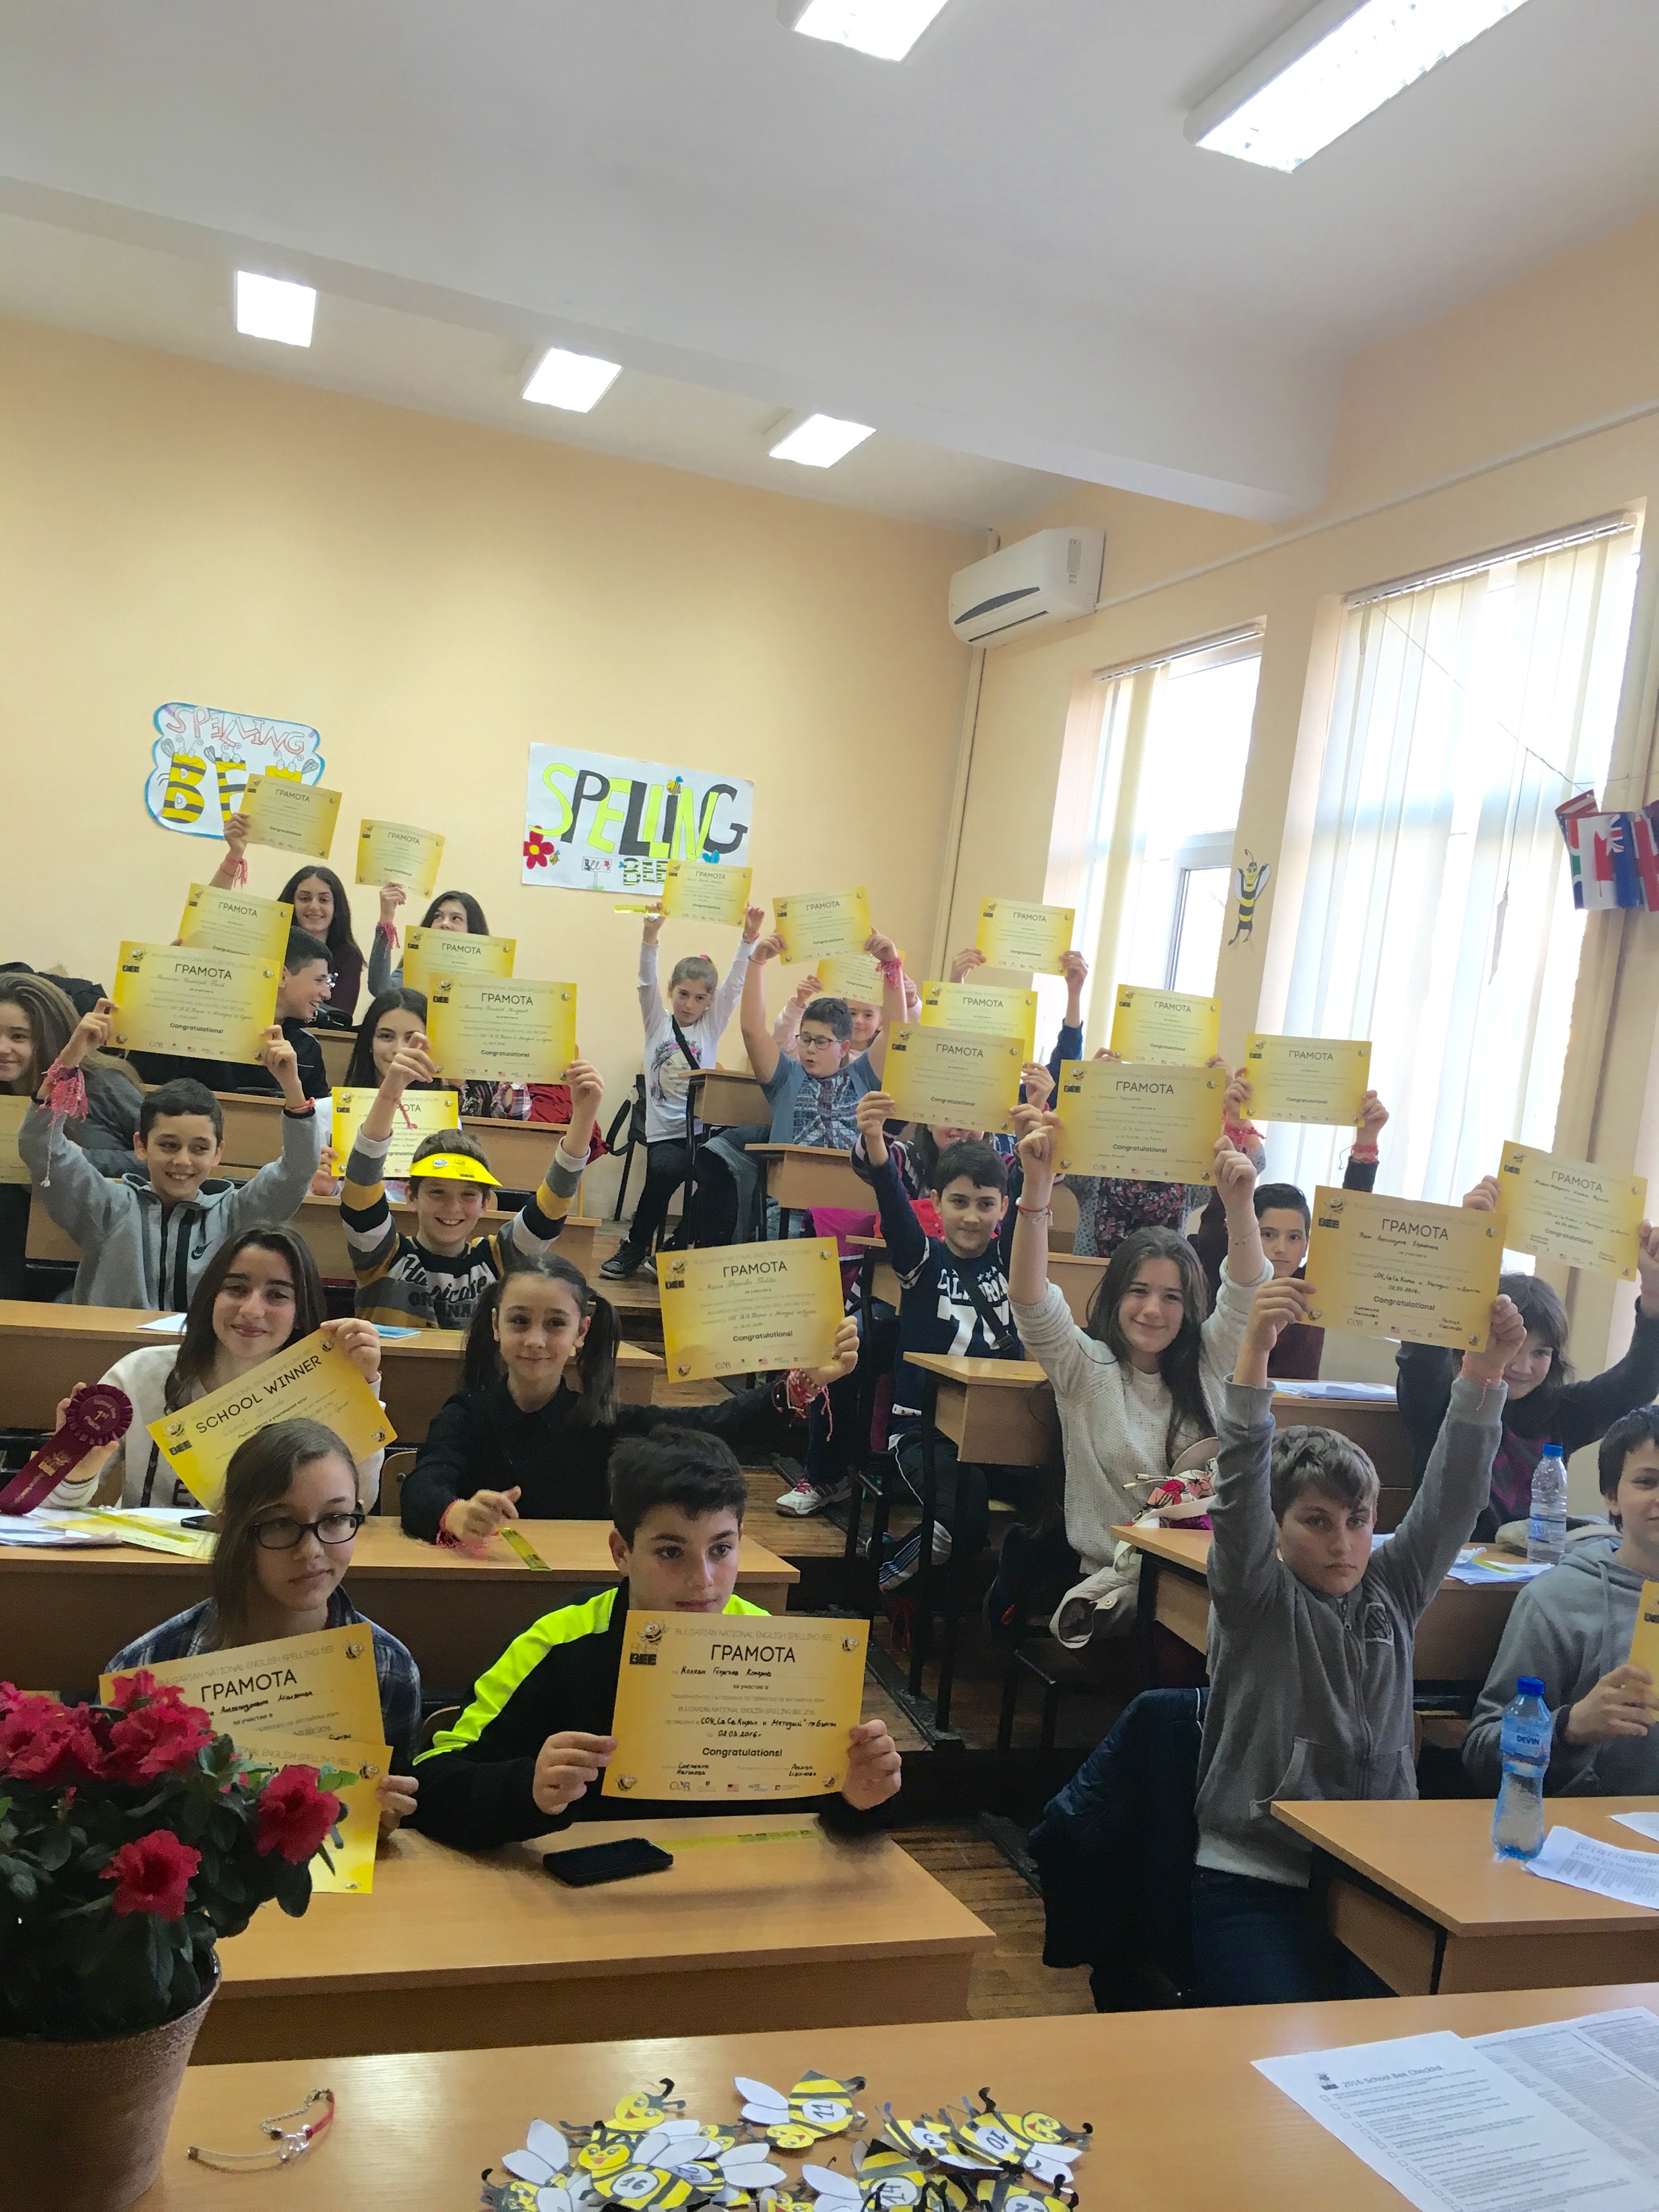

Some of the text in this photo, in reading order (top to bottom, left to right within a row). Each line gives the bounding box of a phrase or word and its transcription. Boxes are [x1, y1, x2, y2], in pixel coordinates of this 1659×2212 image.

[166, 706, 306, 755] SPELLING
[162, 752, 302, 823] BE
[275, 789, 310, 802] ГРАМОТА
[387, 832, 420, 845] ГРАМОТА
[696, 871, 726, 879] ГРАМОТА
[218, 901, 258, 917] ГРАМОТА
[806, 901, 840, 911] ГРАМОТА
[1013, 912, 1047, 923] ГРАМОТА
[442, 943, 482, 955] ГРАМОТА
[174, 964, 232, 980] ГРАМОТА
[481, 993, 534, 1006] ГРАМОТА
[963, 997, 1004, 1008] ГРАМОТА
[1154, 1001, 1192, 1013] ГРАМОТА
[170, 1023, 224, 1034] Congratulations!
[481, 1049, 530, 1058] Congratulations!
[936, 1043, 984, 1058] ГРАМОТА
[1289, 1050, 1334, 1061] ГРАМОТА
[1115, 1081, 1174, 1094] ГРАМОТА
[930, 1097, 975, 1107] Congratulations!
[1113, 1144, 1167, 1153] Congratulations!
[1551, 1171, 1602, 1193] ГРАМОТА
[1318, 1217, 1340, 1229] BEE
[1381, 1218, 1449, 1240] ГРАМОТА
[1544, 1228, 1594, 1245] Congratulations!
[723, 1260, 788, 1278] ГРАМОТА
[1373, 1296, 1435, 1311] Congratulations!
[733, 1330, 793, 1342] Congratulations!
[196, 1355, 322, 1434] SCHOOL WINNER
[169, 1440, 192, 1455] BEE
[676, 1628, 717, 1637] BULGARIAN
[719, 1629, 754, 1638] NATIONAL
[756, 1630, 786, 1639] ENGLISH
[788, 1632, 819, 1640] SPELLING
[247, 1655, 281, 1669] ENGLISH
[282, 1648, 319, 1662] SPELLING
[629, 1654, 657, 1666] BEE
[711, 1644, 795, 1663] ГРАМОТА
[201, 1669, 297, 1702] ГРАМОТА
[1516, 1735, 1540, 1746] DEVIN
[702, 1747, 782, 1758] Congratulations!
[619, 2176, 646, 2191] 16
